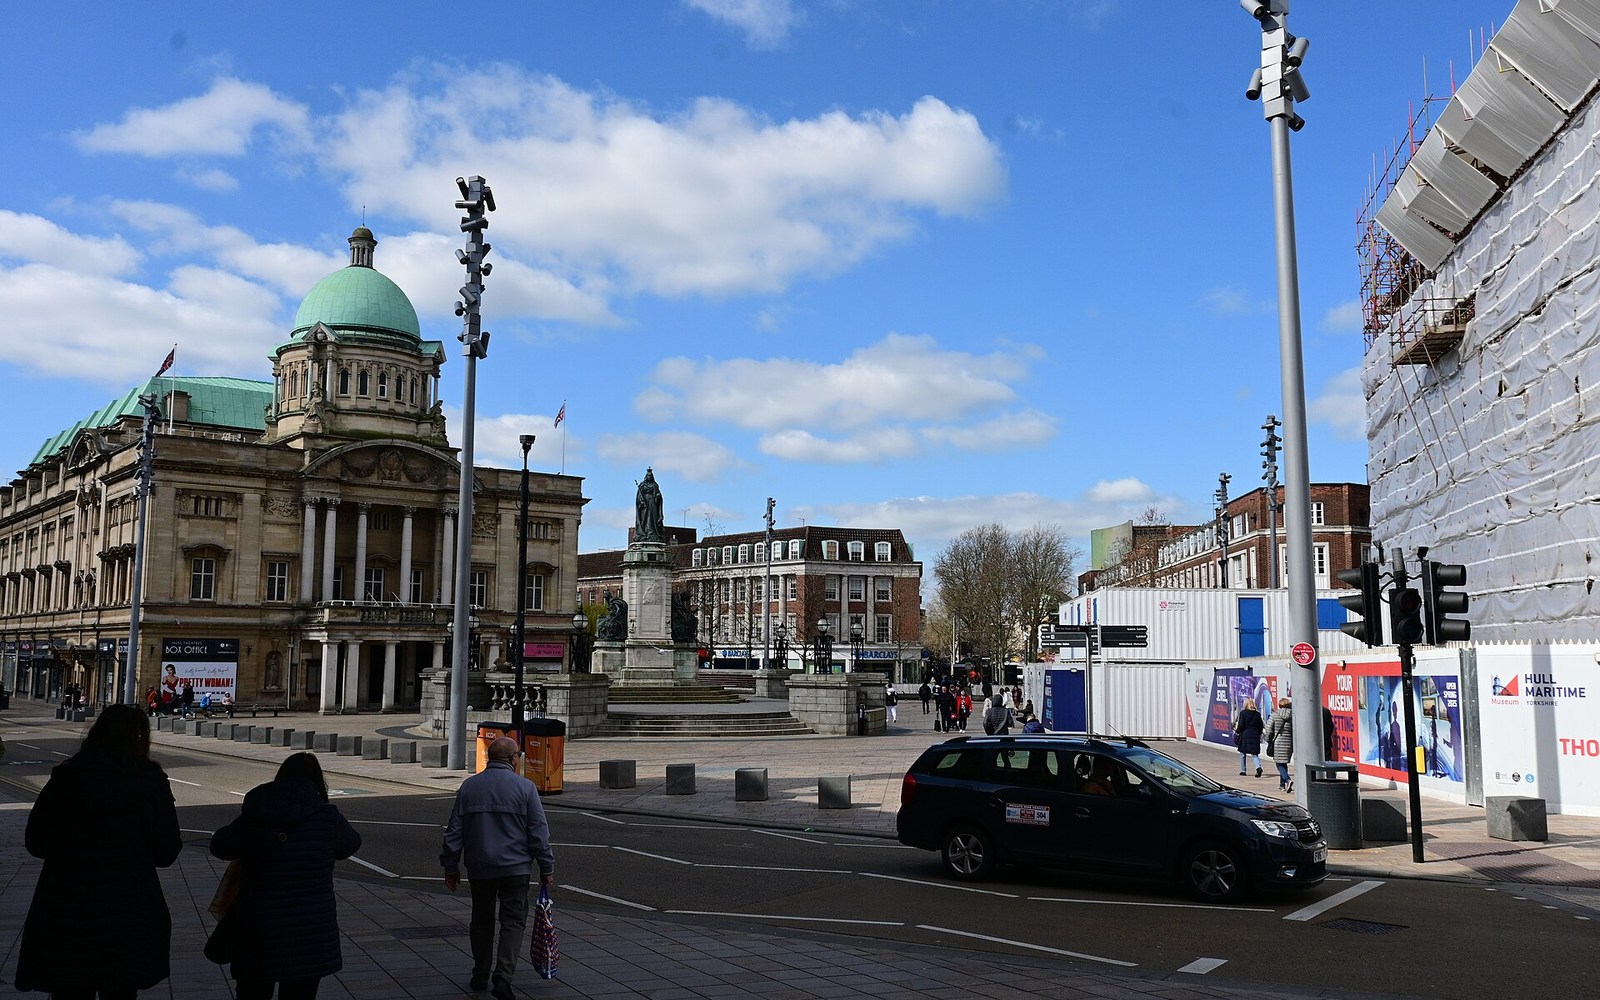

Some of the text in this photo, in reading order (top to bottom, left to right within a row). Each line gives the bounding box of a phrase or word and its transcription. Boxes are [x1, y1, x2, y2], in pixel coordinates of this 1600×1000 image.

[165, 645, 208, 654] BOX OFFICE
[864, 650, 898, 659] BARCLAYS
[179, 678, 234, 688] PRETTY WOMAN!
[1336, 674, 1353, 692] YOUR
[1524, 674, 1556, 684] HULL
[1446, 682, 1456, 690] OPEN
[1443, 690, 1458, 698] SPRING
[1525, 686, 1586, 698] MARITIME
[1328, 694, 1354, 712] MUSEUM
[1447, 699, 1458, 708] 2025
[1332, 715, 1354, 732] ETTING
[1342, 736, 1356, 754] SAIL
